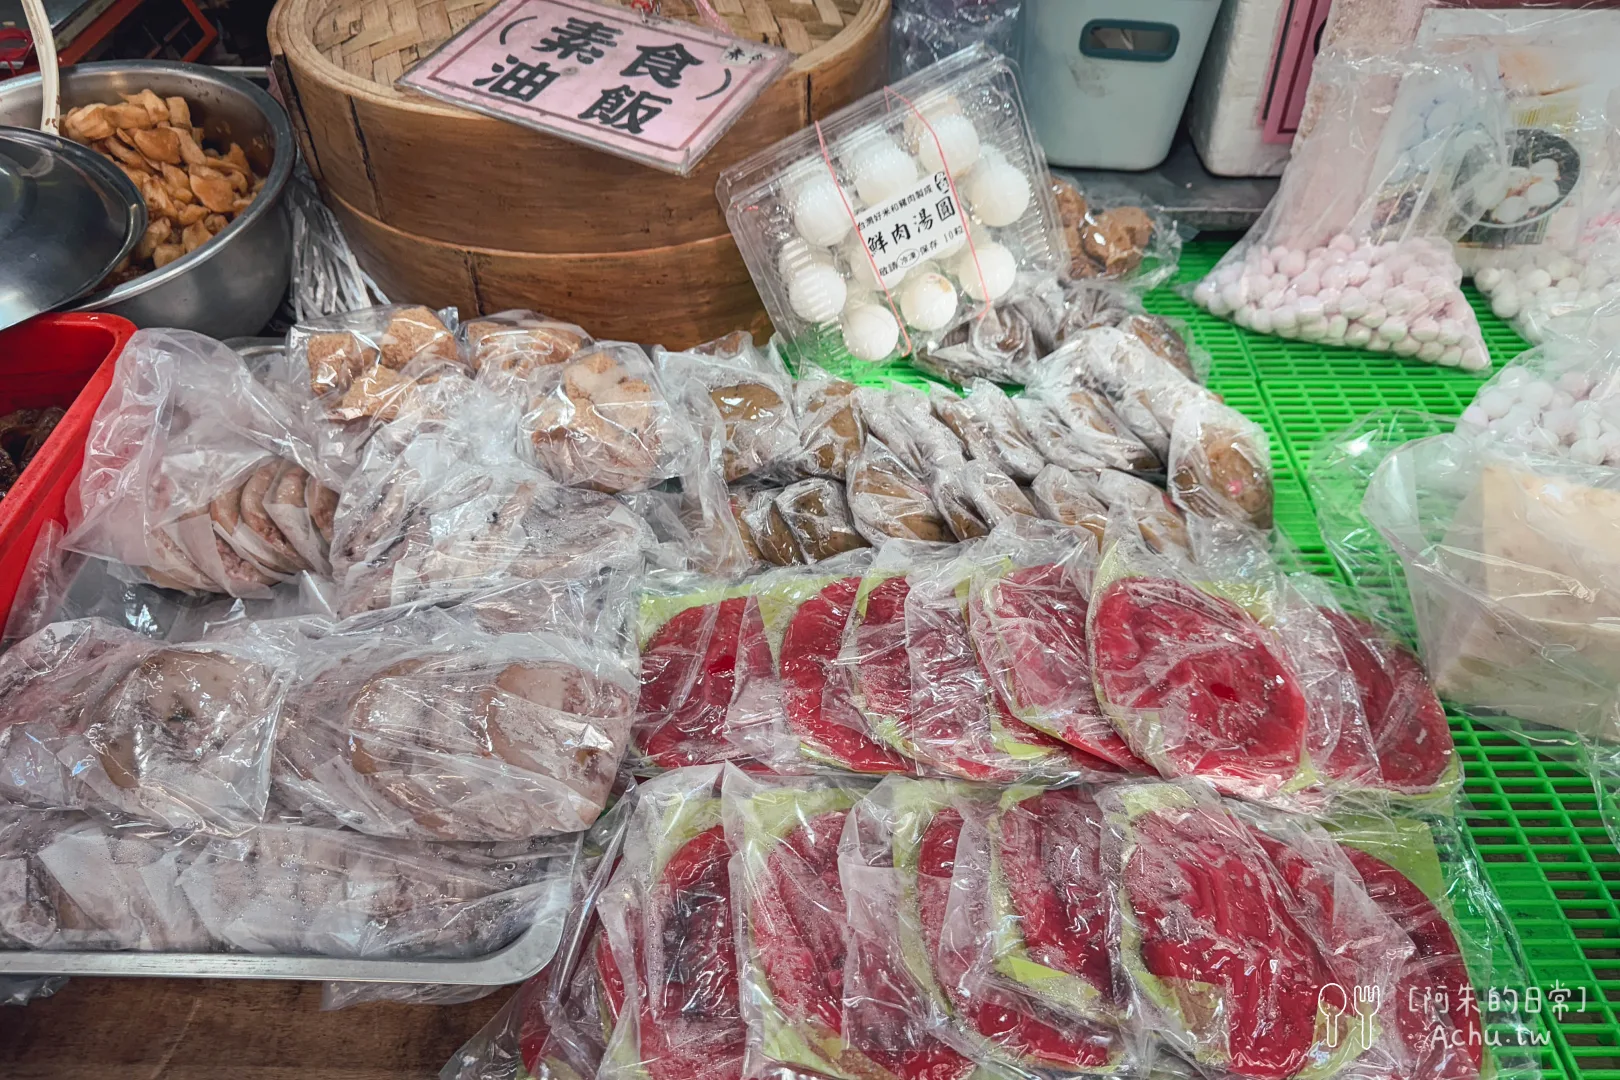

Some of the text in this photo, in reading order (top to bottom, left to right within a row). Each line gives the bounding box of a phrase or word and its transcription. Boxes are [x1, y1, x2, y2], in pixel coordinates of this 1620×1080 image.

[472, 53, 673, 135] 油飯
[867, 195, 956, 257] 鮮肉湯圓
